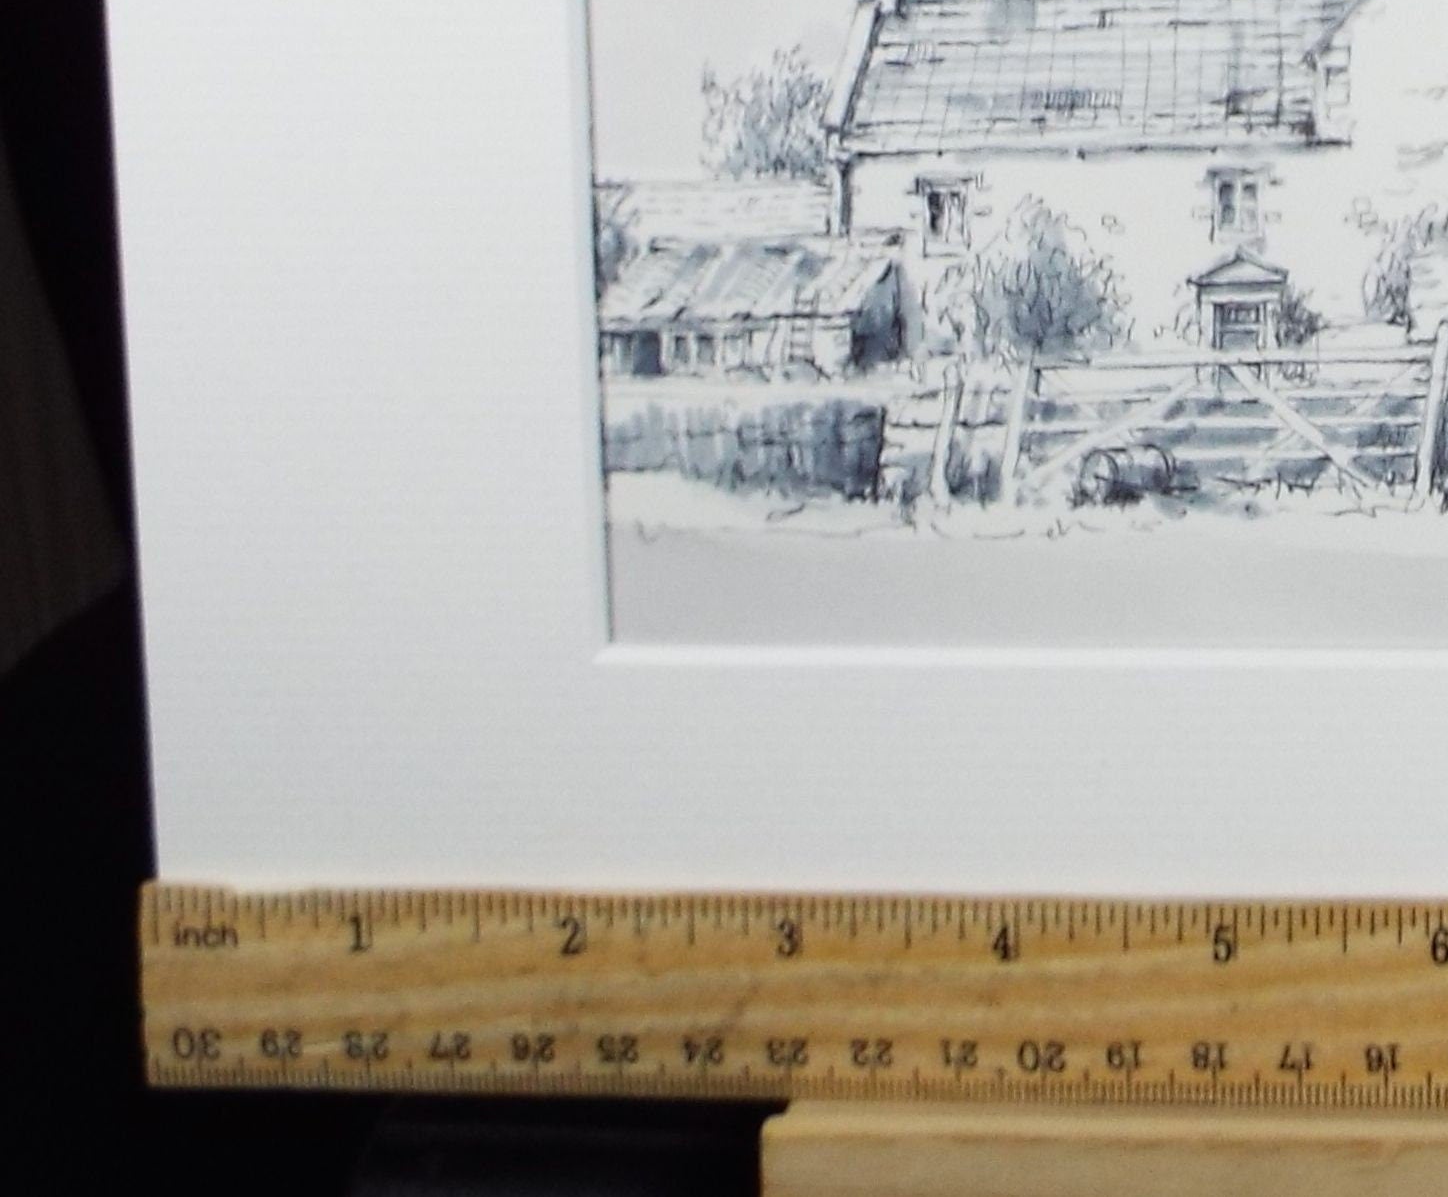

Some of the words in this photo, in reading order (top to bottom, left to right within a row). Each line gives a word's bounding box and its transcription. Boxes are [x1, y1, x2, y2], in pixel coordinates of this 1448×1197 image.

[173, 921, 238, 949] inch
[348, 914, 369, 952] 1
[560, 916, 585, 955] 2
[777, 919, 799, 957] 3
[992, 921, 1013, 962] 4
[1212, 924, 1233, 964] 5
[173, 1026, 222, 1061] 30
[261, 1029, 302, 1059] 29
[344, 1030, 389, 1060] 28
[428, 1031, 471, 1060] 27
[512, 1033, 556, 1062] 26
[597, 1033, 639, 1062] 25
[683, 1034, 725, 1063] 24
[766, 1035, 808, 1065] 23
[851, 1037, 893, 1066] 22
[940, 1039, 978, 1067] 21
[1017, 1039, 1066, 1072] 20
[1106, 1041, 1143, 1070] 19
[1191, 1041, 1229, 1070] 18
[1279, 1042, 1314, 1071] 17
[1364, 1043, 1400, 1072] 16
